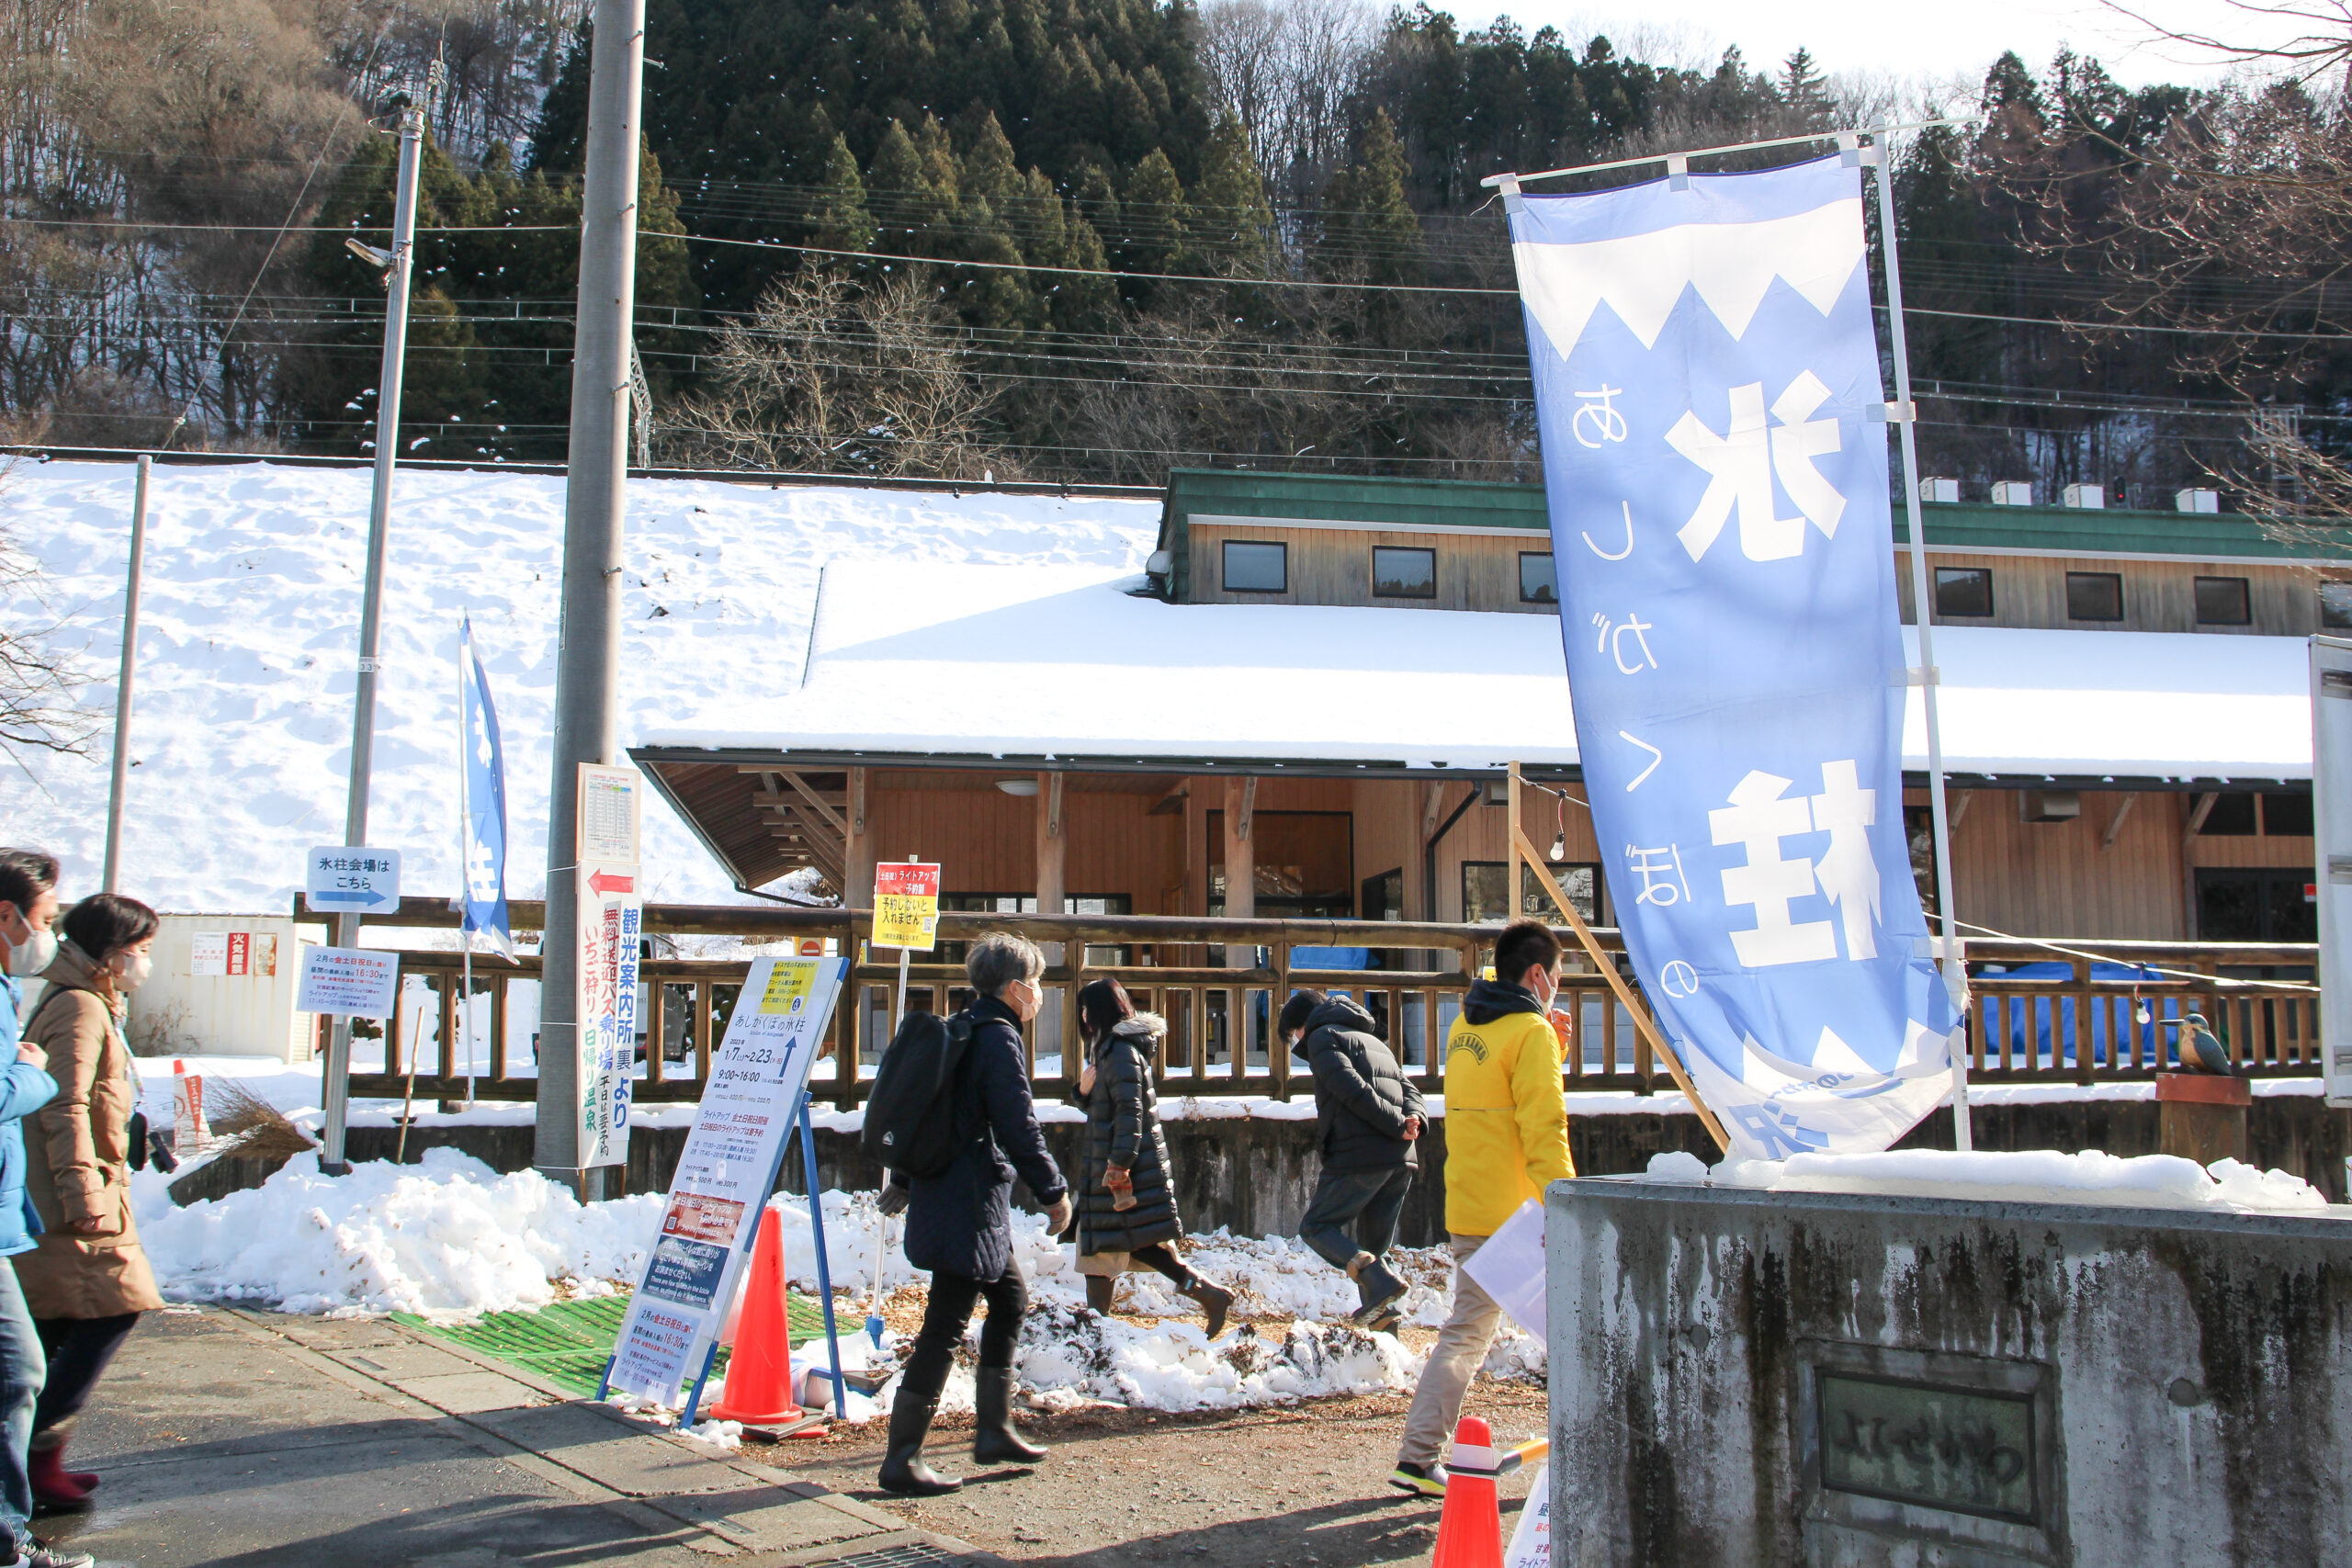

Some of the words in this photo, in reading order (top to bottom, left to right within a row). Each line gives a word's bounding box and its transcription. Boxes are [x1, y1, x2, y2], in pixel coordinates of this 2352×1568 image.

[319, 857, 390, 873] 氷柱会場は
[337, 876, 371, 889] こちら
[899, 870, 937, 882] ライトアップ
[882, 897, 927, 911] 予約しないと
[735, 1014, 806, 1032] あしがくぼの氷柱
[704, 1110, 731, 1121] ライトアップ
